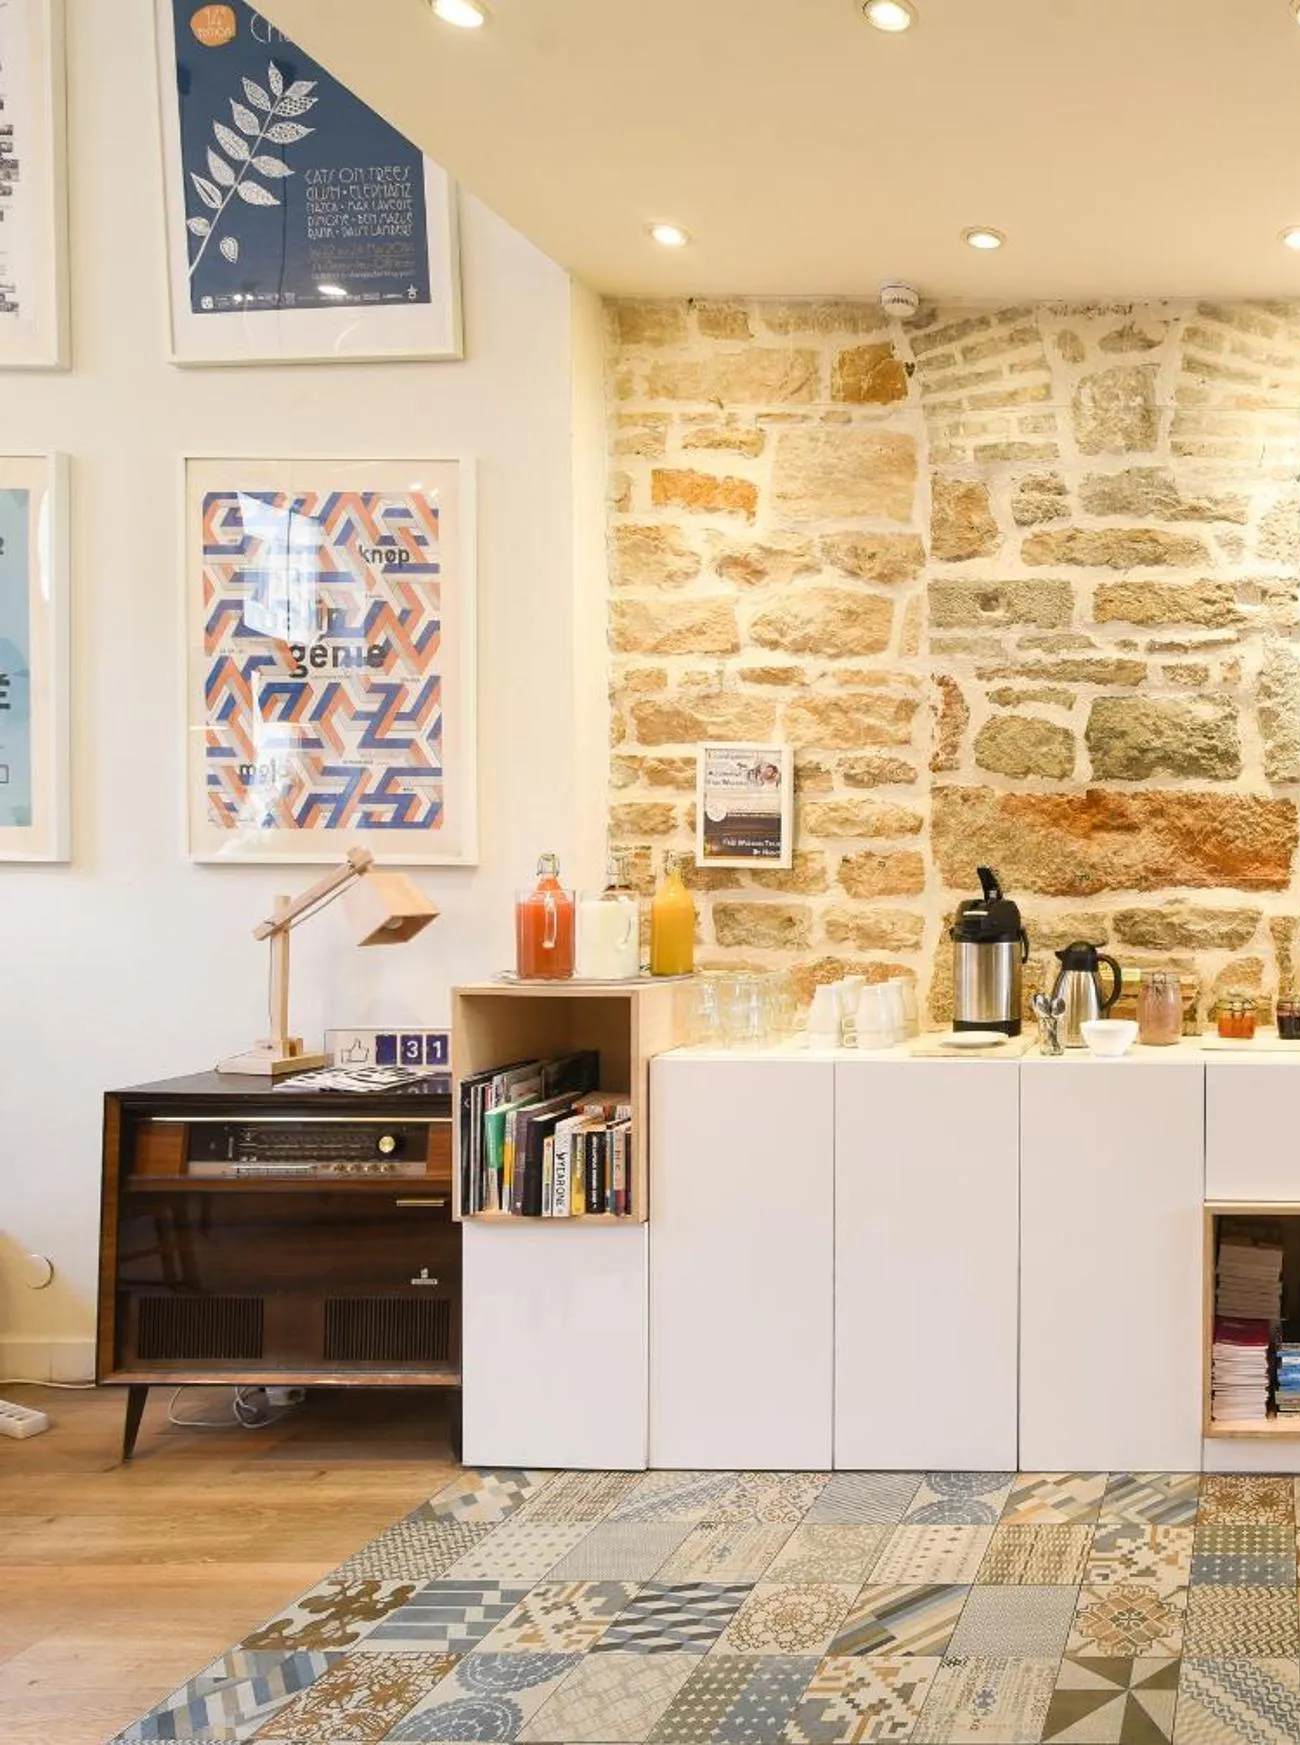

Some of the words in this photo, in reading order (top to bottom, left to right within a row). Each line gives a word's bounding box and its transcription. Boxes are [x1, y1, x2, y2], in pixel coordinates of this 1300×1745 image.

[304, 168, 335, 184] CATS
[340, 167, 364, 182] ON
[368, 165, 411, 181] TREES
[288, 634, 389, 679] génie
